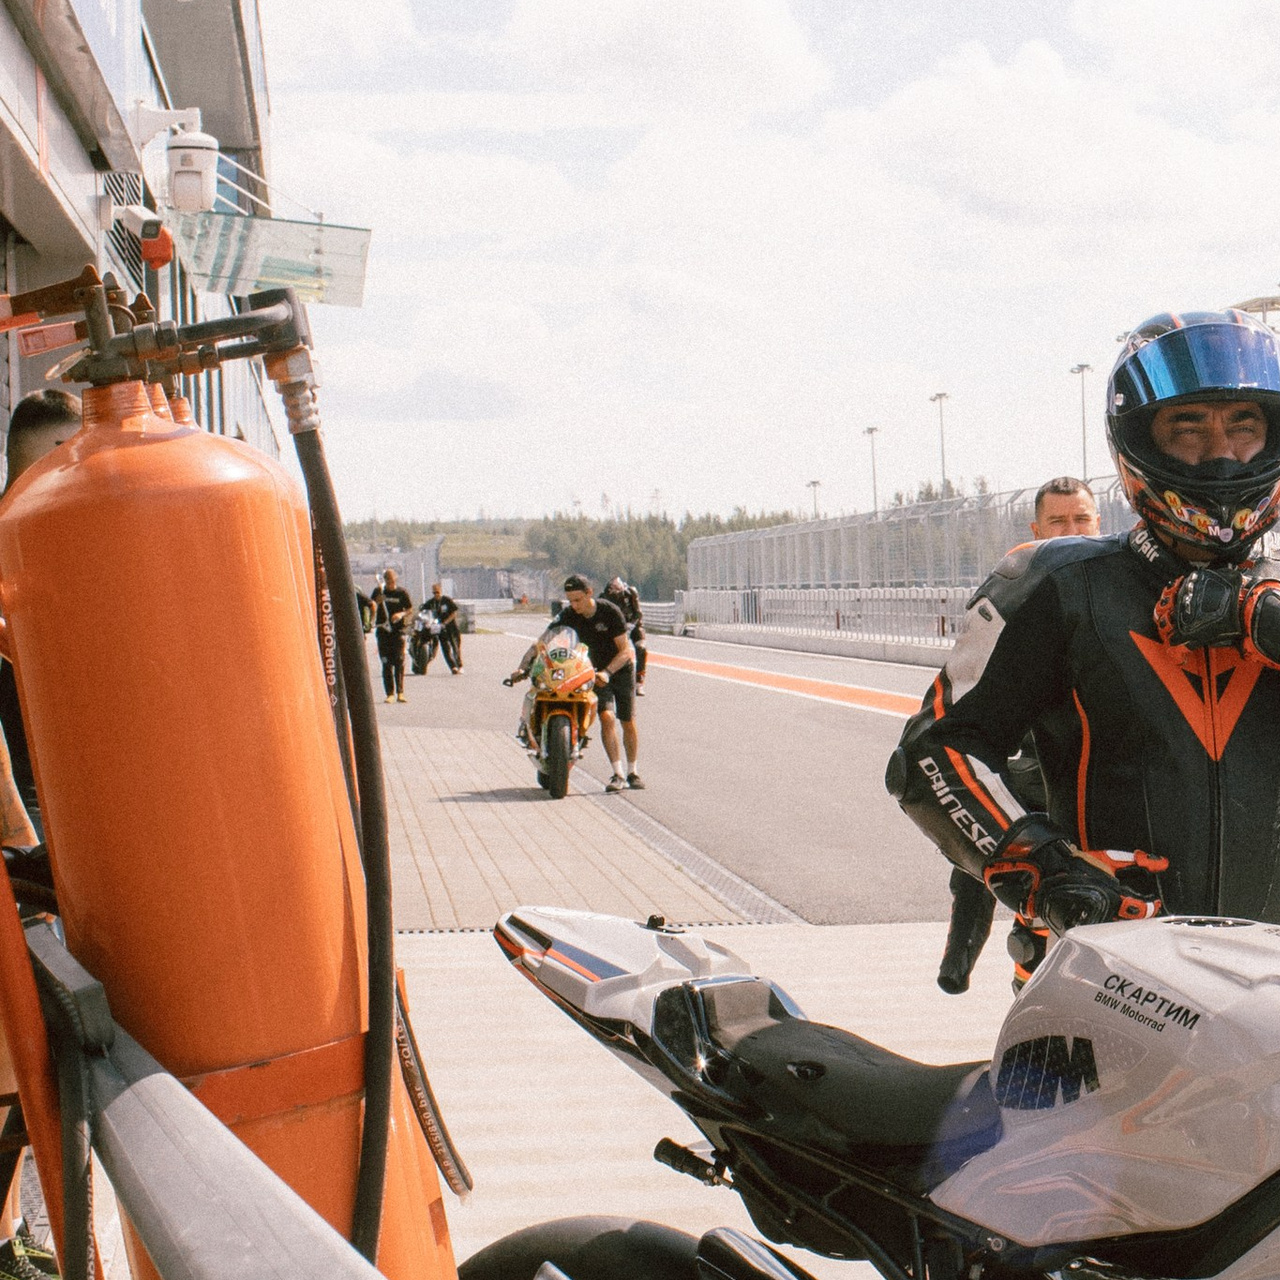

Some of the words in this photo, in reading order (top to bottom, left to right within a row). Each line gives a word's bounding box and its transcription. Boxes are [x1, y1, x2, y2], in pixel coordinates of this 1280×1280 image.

[322, 588, 337, 687] GIDROPROM
[918, 756, 998, 856] DAINESE
[1094, 991, 1121, 1011] BMW
[1120, 1003, 1166, 1032] Motorrad
[1103, 974, 1201, 1030] СКАРТИМ
[414, 1085, 427, 1108] bar
